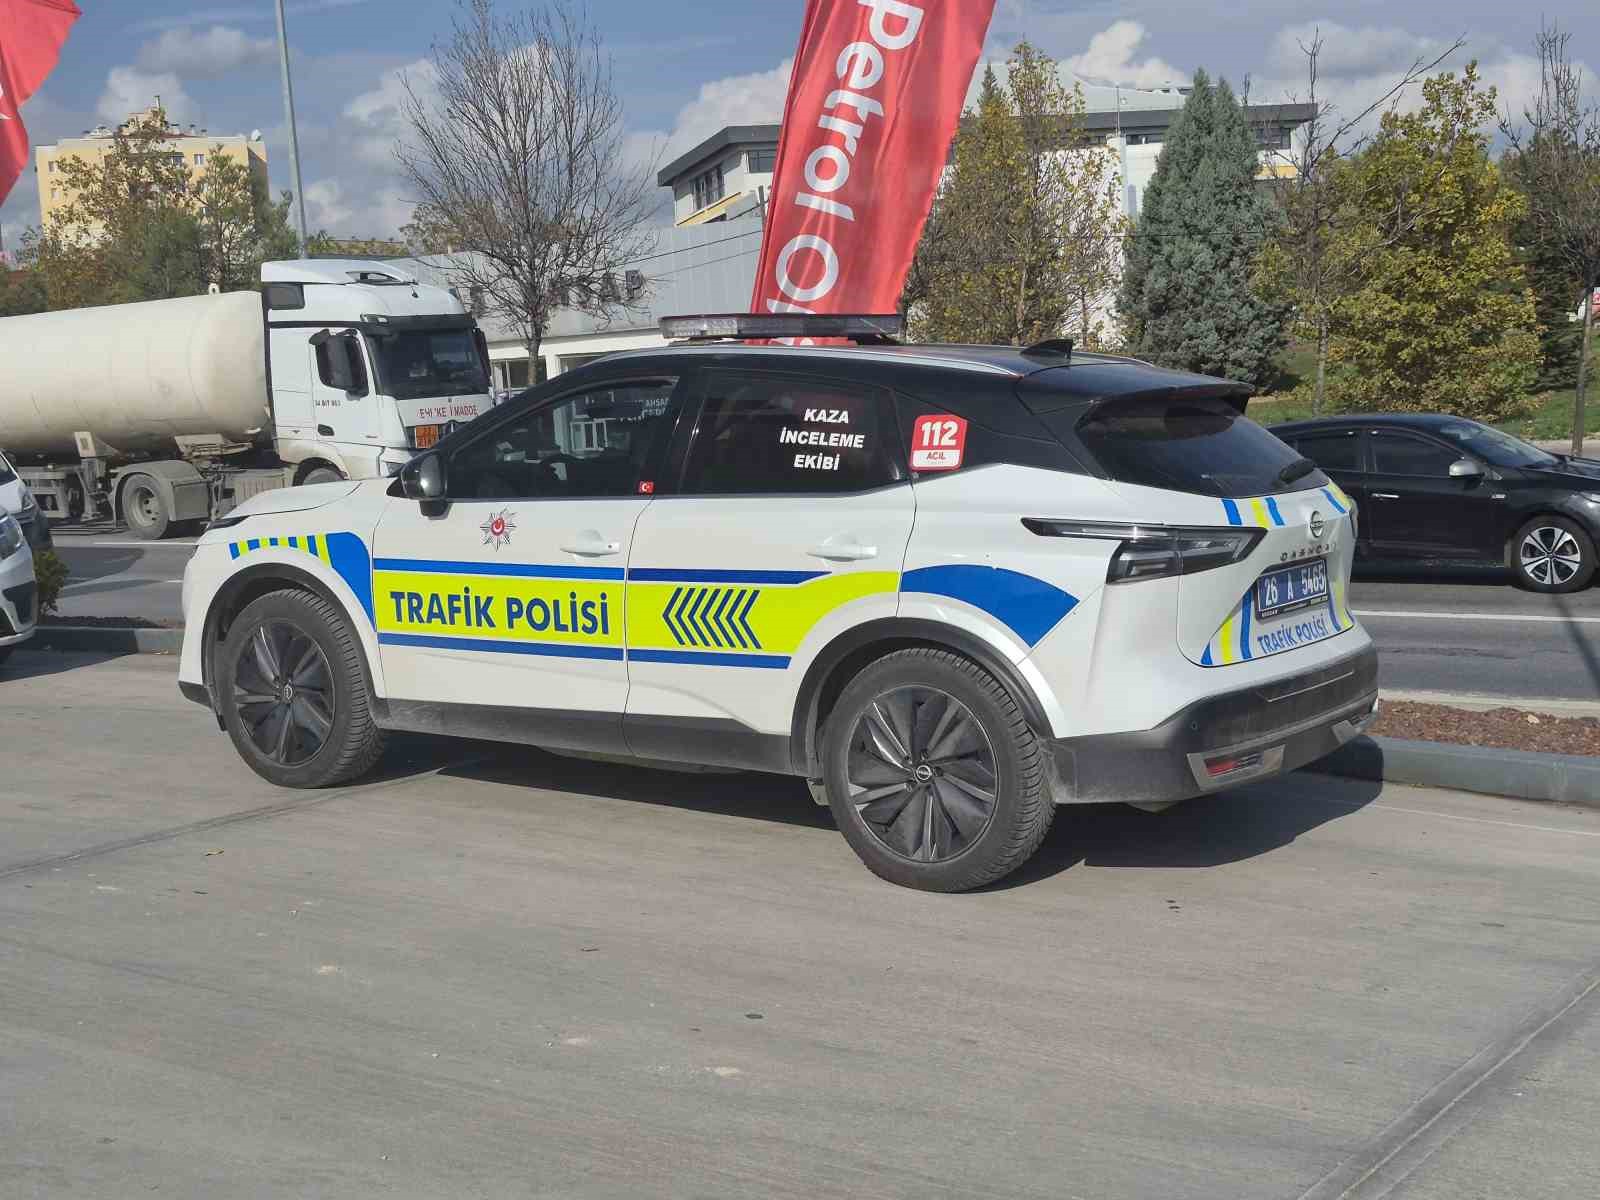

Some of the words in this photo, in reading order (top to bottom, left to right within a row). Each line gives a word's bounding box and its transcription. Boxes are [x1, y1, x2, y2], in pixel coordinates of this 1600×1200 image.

[795, 0, 924, 223] Petrol
[803, 408, 850, 425] KAZA
[779, 427, 865, 449] İNCELEME
[921, 420, 959, 447] 112
[793, 452, 841, 471] EKİBİ
[1264, 575, 1278, 606] 26
[1287, 570, 1294, 600] A
[390, 586, 496, 628] TRAFİK
[506, 591, 609, 635] POLİSİ
[1257, 623, 1297, 654] TRAFİK
[1296, 612, 1329, 642] POLİSİ
